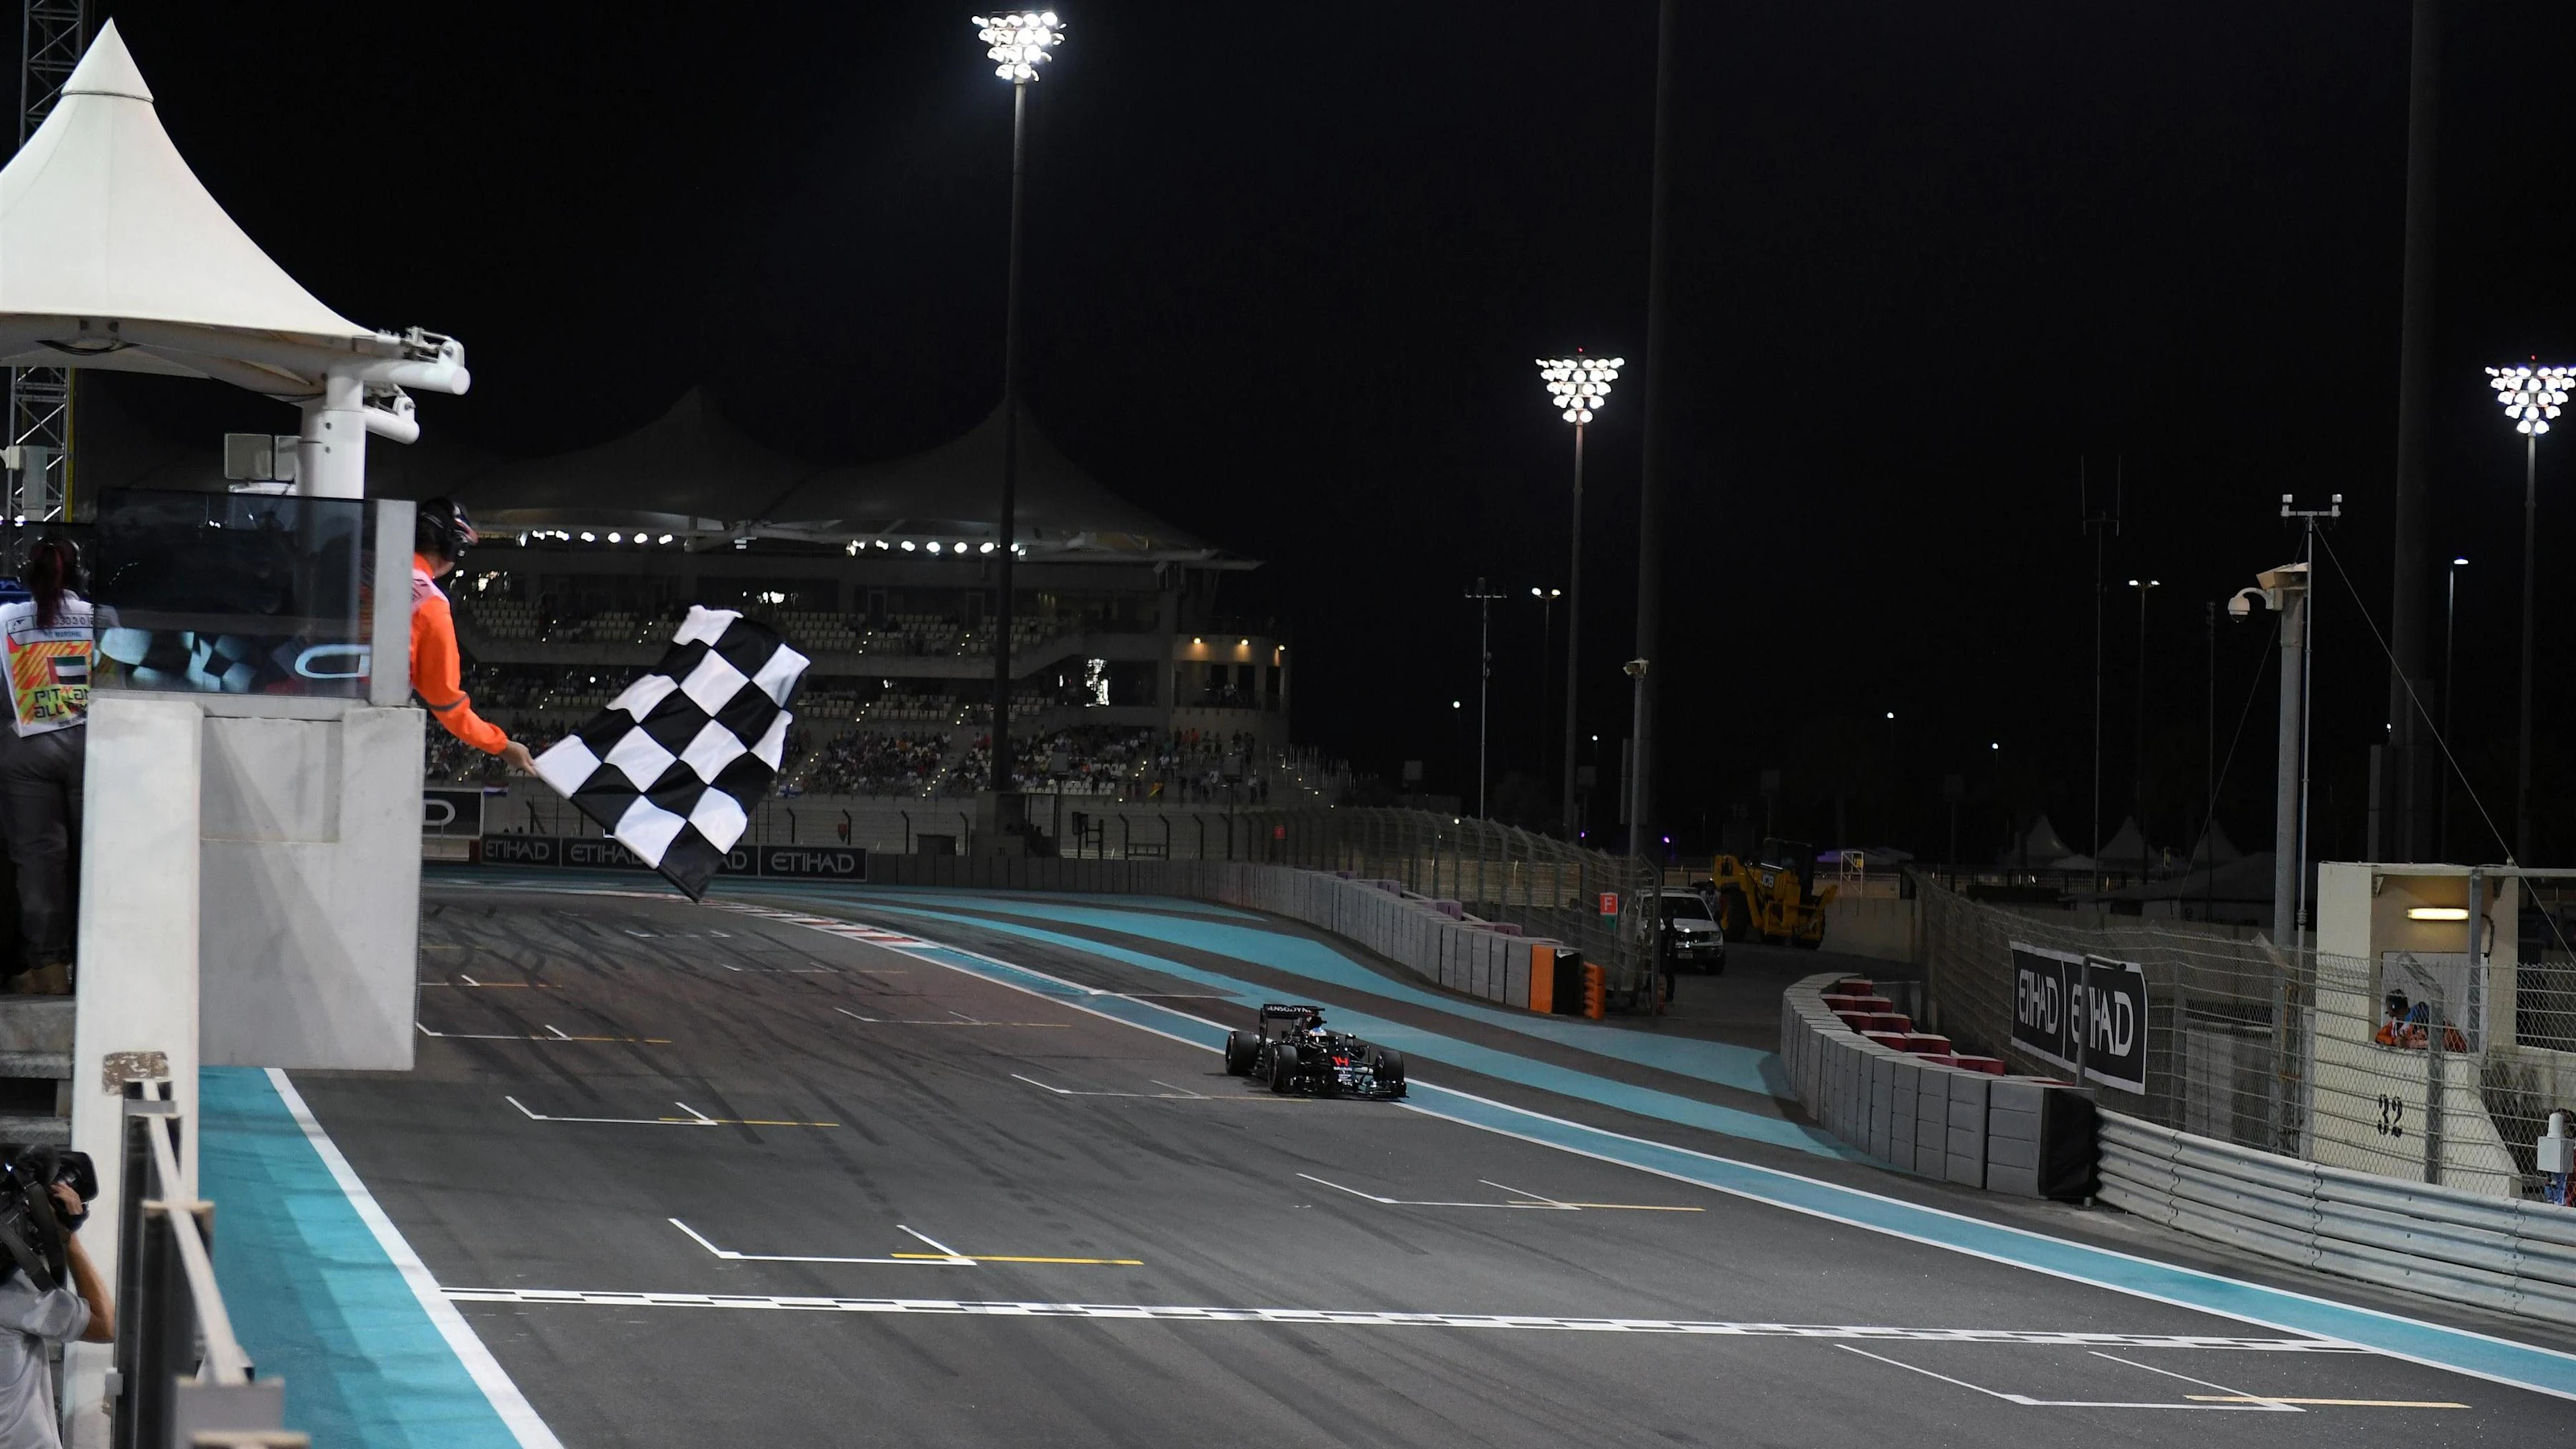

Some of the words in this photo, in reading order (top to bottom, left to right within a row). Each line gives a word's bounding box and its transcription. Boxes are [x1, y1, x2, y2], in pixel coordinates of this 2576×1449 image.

[485, 839, 550, 860] ETIHAD
[771, 852, 855, 873] ETIHAD
[2018, 968, 2058, 1034] ETIHAD
[2071, 984, 2133, 1057] EIHAD
[1331, 1055, 1350, 1067] 14
[2377, 1093, 2403, 1138] 32
